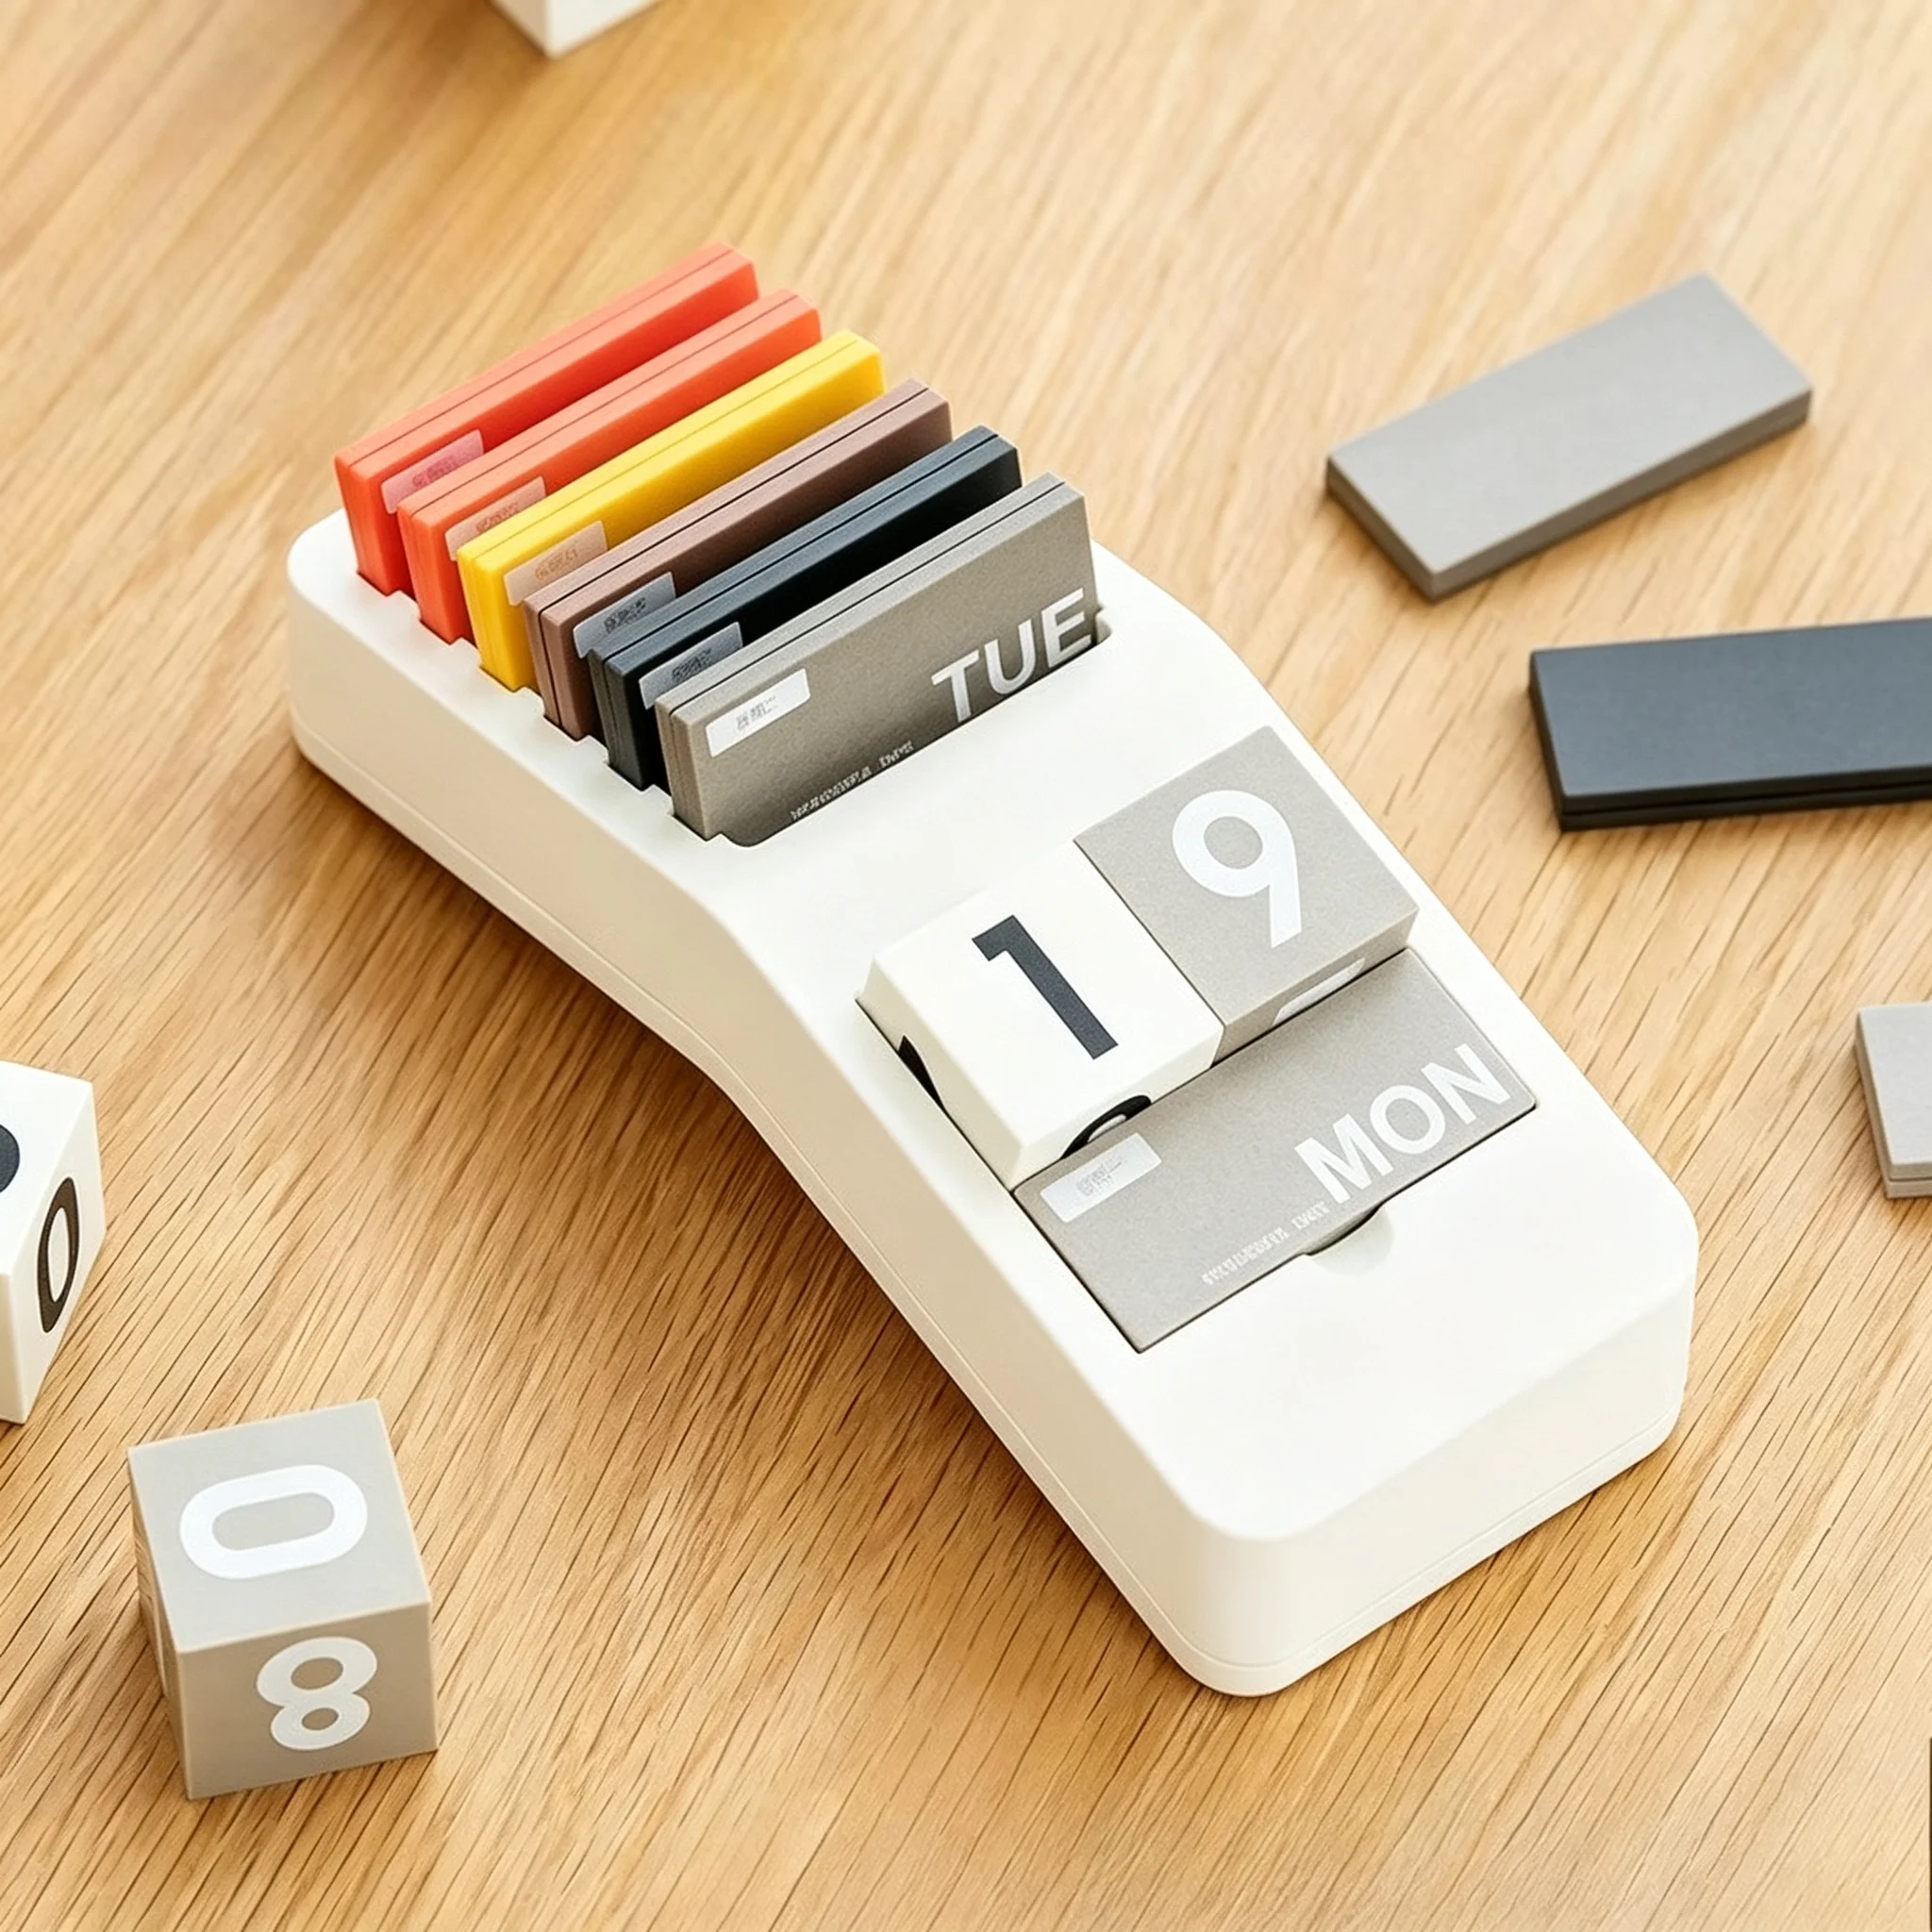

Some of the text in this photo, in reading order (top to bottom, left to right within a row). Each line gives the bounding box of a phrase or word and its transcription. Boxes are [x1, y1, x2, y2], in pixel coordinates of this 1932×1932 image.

[930, 589, 1093, 724] TUE
[1294, 1042, 1512, 1204] MON
[37, 1177, 80, 1333] 0
[179, 1464, 369, 1580] 0
[256, 1636, 378, 1752] 8
